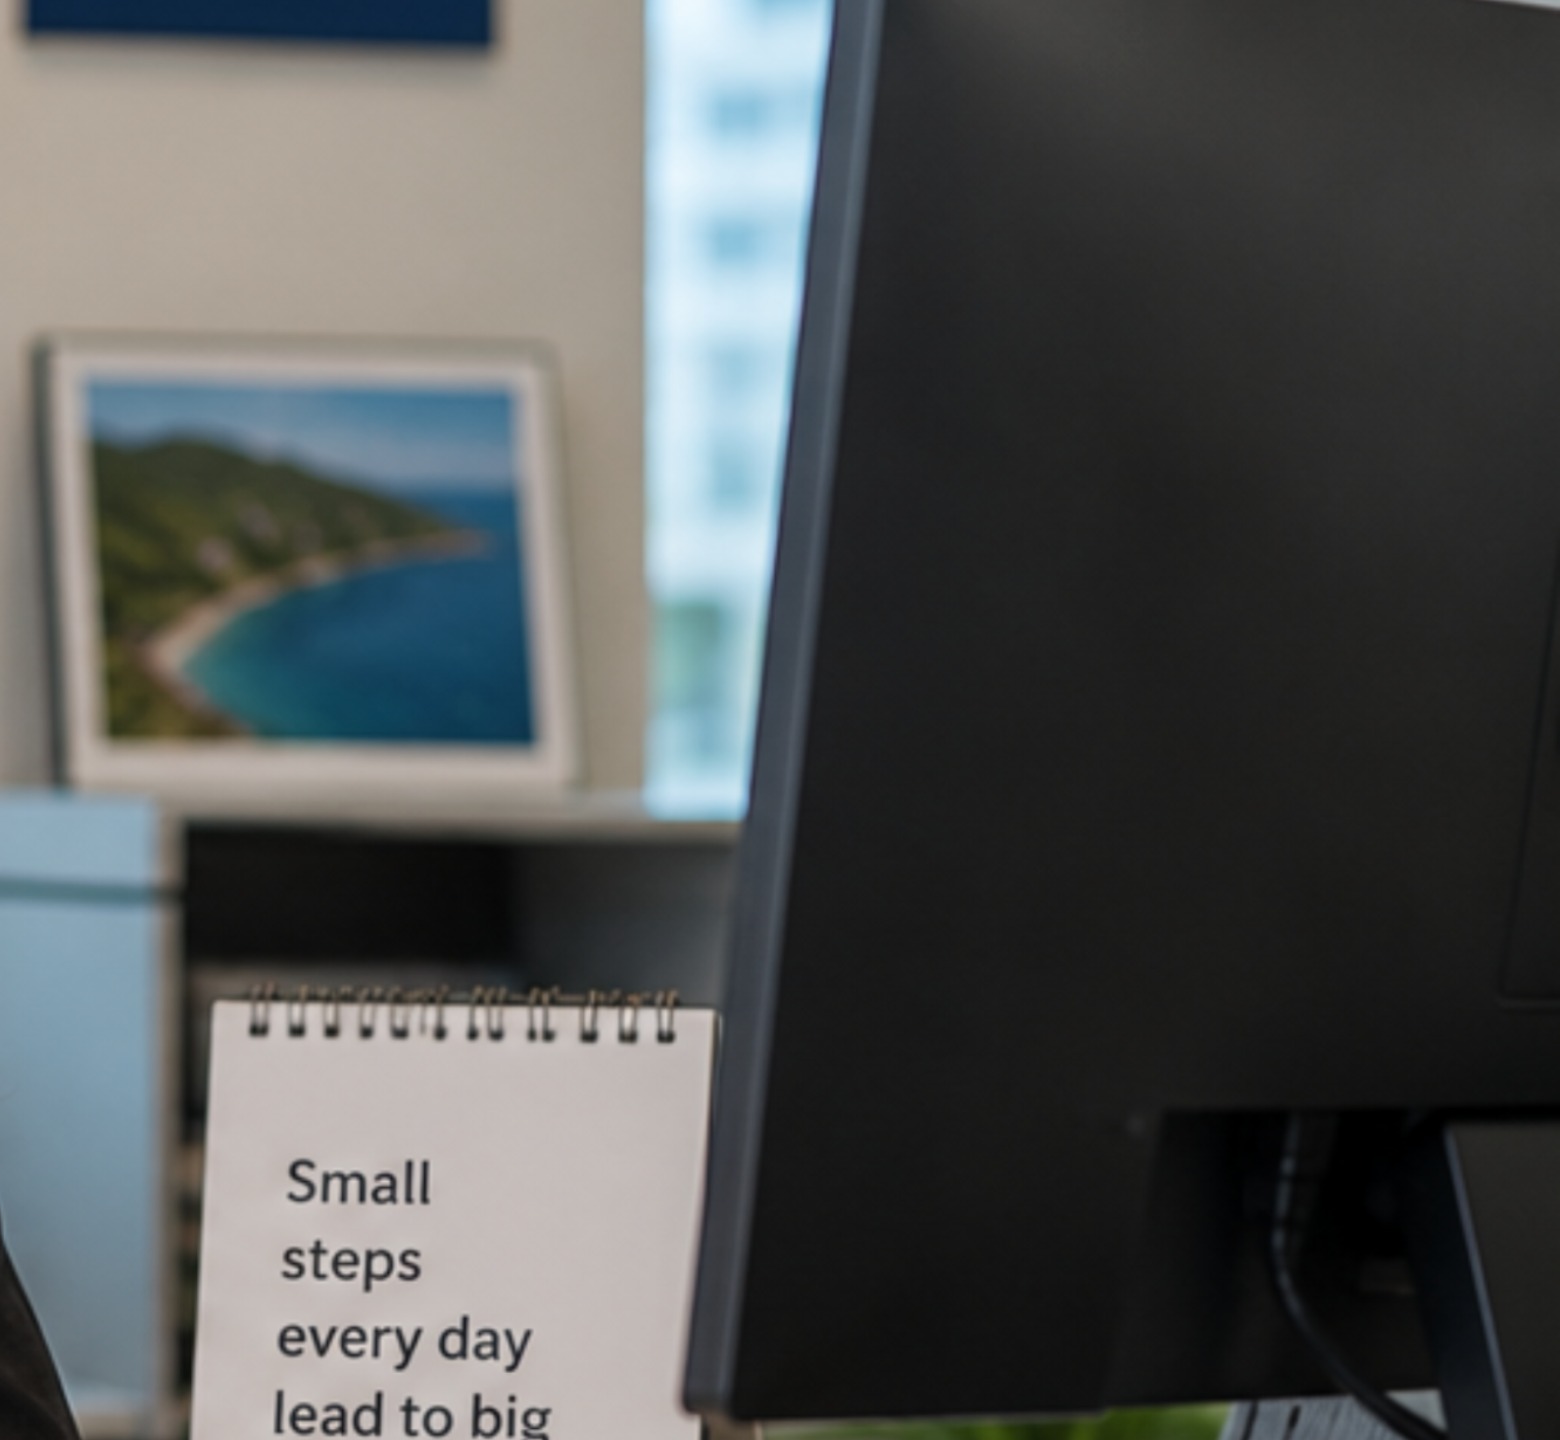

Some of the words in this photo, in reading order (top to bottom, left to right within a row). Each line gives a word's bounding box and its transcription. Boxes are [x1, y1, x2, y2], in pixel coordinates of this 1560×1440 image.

[286, 1158, 431, 1205] Small
[281, 1240, 422, 1293] steps
[277, 1324, 423, 1371] every
[437, 1315, 533, 1373] day
[273, 1390, 383, 1436] lead
[399, 1396, 453, 1438] to
